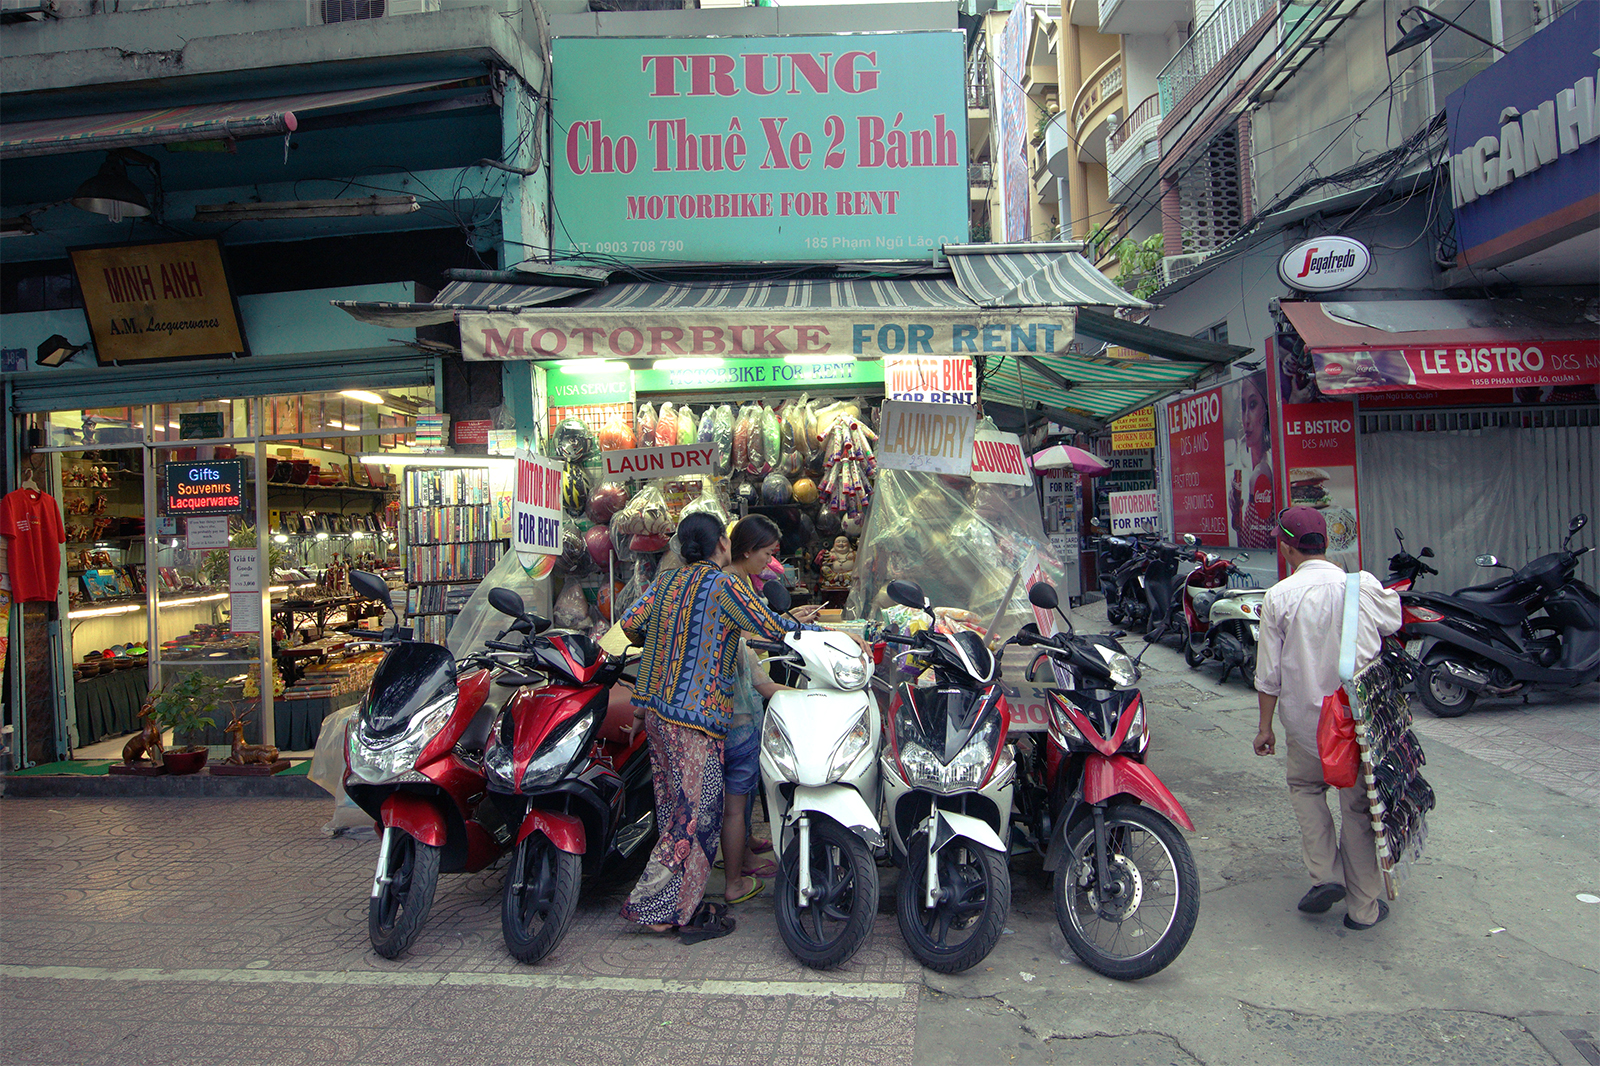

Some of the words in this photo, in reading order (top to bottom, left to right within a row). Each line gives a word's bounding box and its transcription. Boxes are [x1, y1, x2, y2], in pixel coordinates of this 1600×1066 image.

[641, 50, 881, 97] TRUNG
[566, 119, 638, 175] Cho
[648, 116, 747, 172] Thuê
[760, 117, 812, 170] Xe
[823, 114, 847, 170] 2
[856, 112, 960, 169] Bánh
[1449, 100, 1558, 209] NGÂN
[626, 193, 774, 220] MOTORBIKE
[780, 191, 828, 218] FOR
[835, 190, 900, 217] RENT
[596, 241, 628, 253] 0903
[632, 240, 656, 252] 708
[660, 240, 684, 251] 790
[804, 236, 828, 249] 185
[832, 236, 871, 250] Phạm
[876, 235, 903, 250] Ngũ
[908, 235, 934, 247] Lão
[1297, 247, 1355, 278] Segafredo
[103, 265, 156, 303] MINH
[160, 261, 203, 299] ANH
[110, 317, 143, 336] A.M.
[146, 316, 219, 335] Lacquerwares
[481, 325, 831, 358] MOTORBIKE
[853, 323, 935, 355] FOR
[952, 323, 1062, 353] RENT
[1420, 349, 1451, 375] LE
[1455, 346, 1544, 373] BISTRO
[1551, 353, 1580, 371] DES
[669, 365, 765, 386] MOTORBIKE
[772, 364, 803, 382] FOR
[812, 362, 855, 380] RENT
[892, 359, 938, 392] MOTOR
[943, 359, 974, 391] BIKE
[1491, 377, 1514, 386] PHẠM
[1516, 375, 1532, 384] NGŨ
[555, 385, 579, 396] VISA
[581, 382, 627, 395] SERVICE
[1169, 404, 1180, 434] LE
[1181, 392, 1220, 431] BISTRO
[883, 411, 970, 459] LAUNDRY
[1114, 433, 1138, 442] BROKEN
[1139, 432, 1153, 440] RICE
[1287, 421, 1302, 435] LE
[1305, 419, 1351, 434] BISTRO
[1180, 436, 1192, 456] DES
[1193, 431, 1209, 453] AMIS
[1302, 438, 1317, 449] DES
[1319, 438, 1338, 448] AMIS
[607, 453, 664, 474] LAUN
[670, 448, 714, 469] DRY
[971, 440, 1026, 476] LAUNDRY
[1122, 458, 1143, 468] RENT
[189, 468, 220, 481] Gifts
[517, 458, 543, 506] MOTOR
[545, 468, 561, 511] BIKE
[178, 483, 231, 495] Souvenirs
[1050, 482, 1063, 492] FOR
[170, 495, 239, 510] Lacquerwares
[1111, 493, 1157, 515] MOTORBIKE
[518, 511, 535, 545] FOR
[537, 516, 560, 549] RENT
[1113, 518, 1131, 530] FOR
[233, 555, 246, 563] Giá
